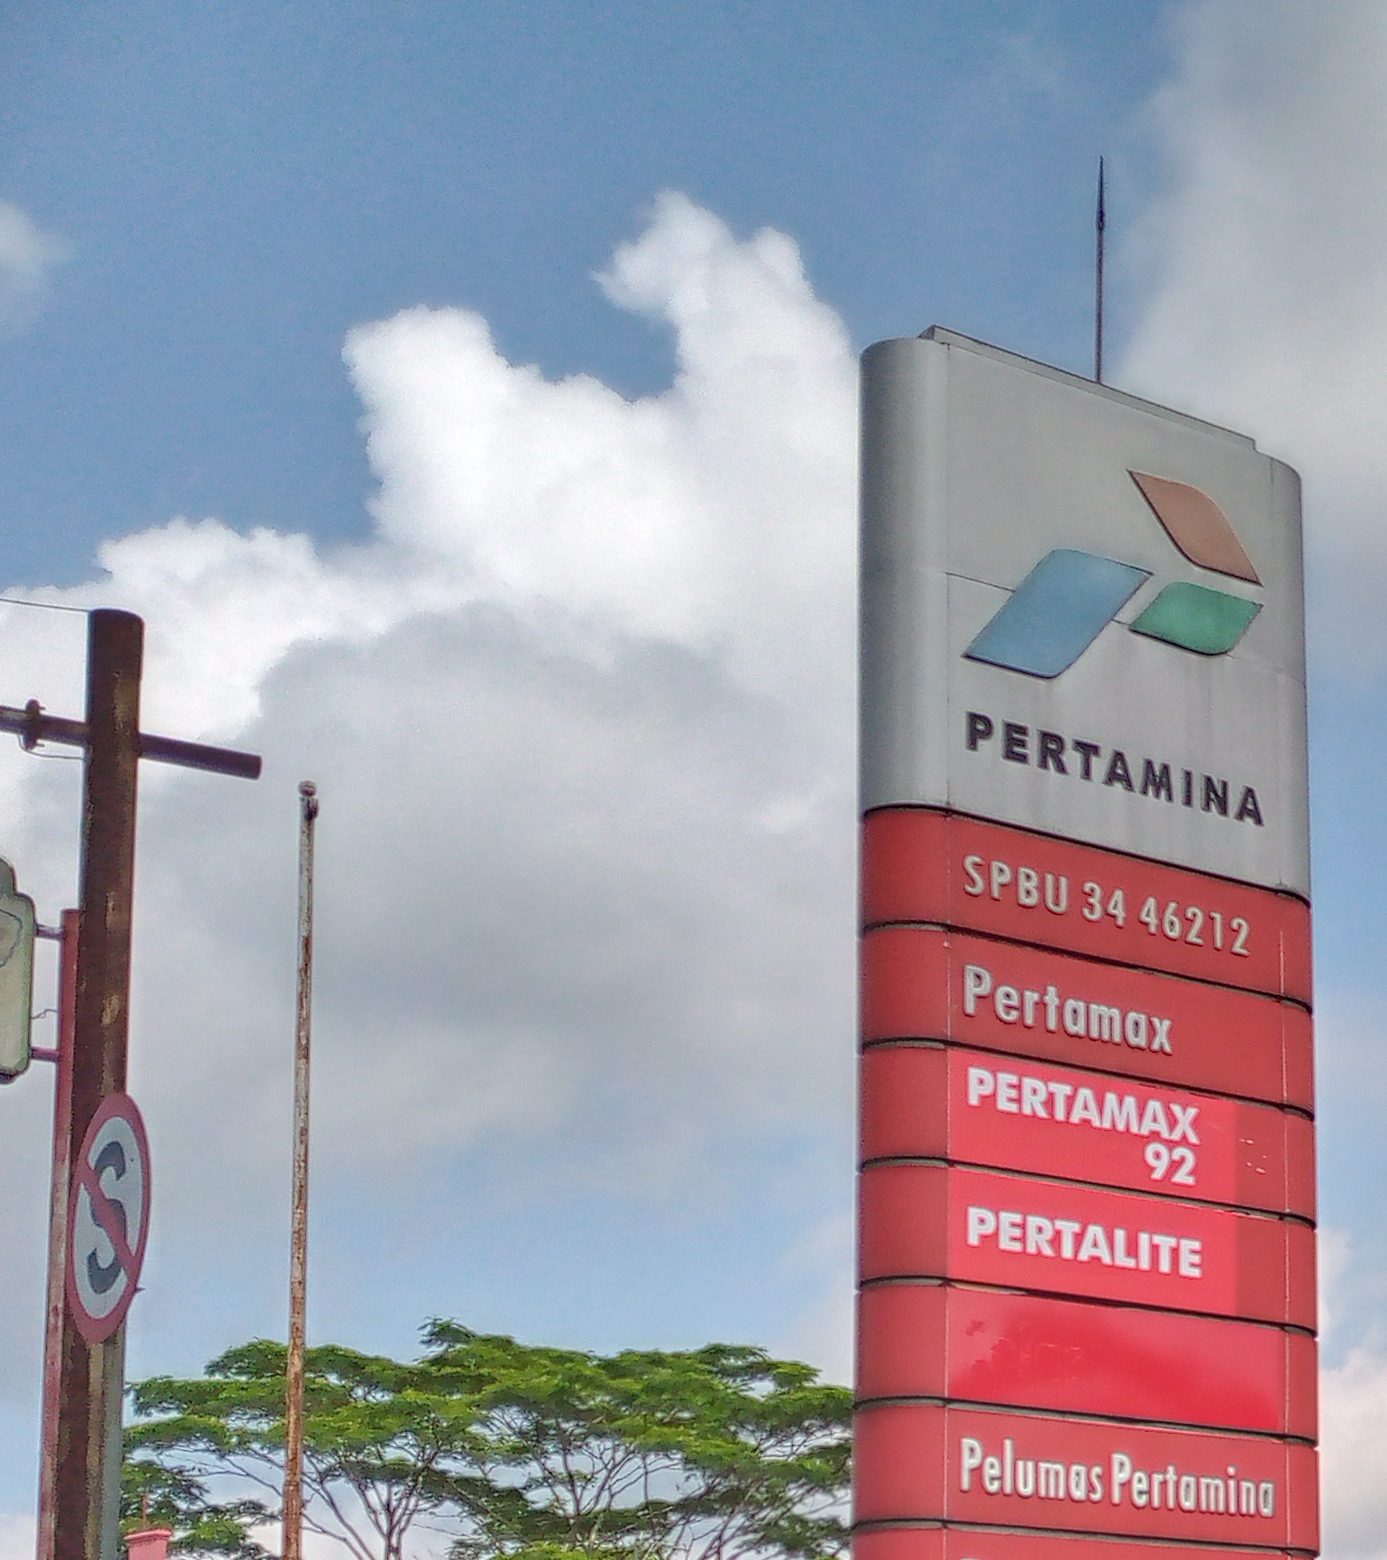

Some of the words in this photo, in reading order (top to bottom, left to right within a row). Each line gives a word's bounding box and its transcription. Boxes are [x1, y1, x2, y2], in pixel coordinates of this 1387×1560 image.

[966, 711, 1264, 826] PERTAMINA
[963, 854, 1069, 914] SPBU
[1083, 881, 1126, 928] 34
[1138, 896, 1250, 957] 46212
[962, 964, 1173, 1055] Pertamax
[967, 1067, 1200, 1146] PERTAMAX
[1143, 1143, 1196, 1186] 92
[966, 1206, 1202, 1278] PERTALITE
[960, 1437, 1102, 1504] Pelumas
[1110, 1452, 1275, 1518] Pertamina
